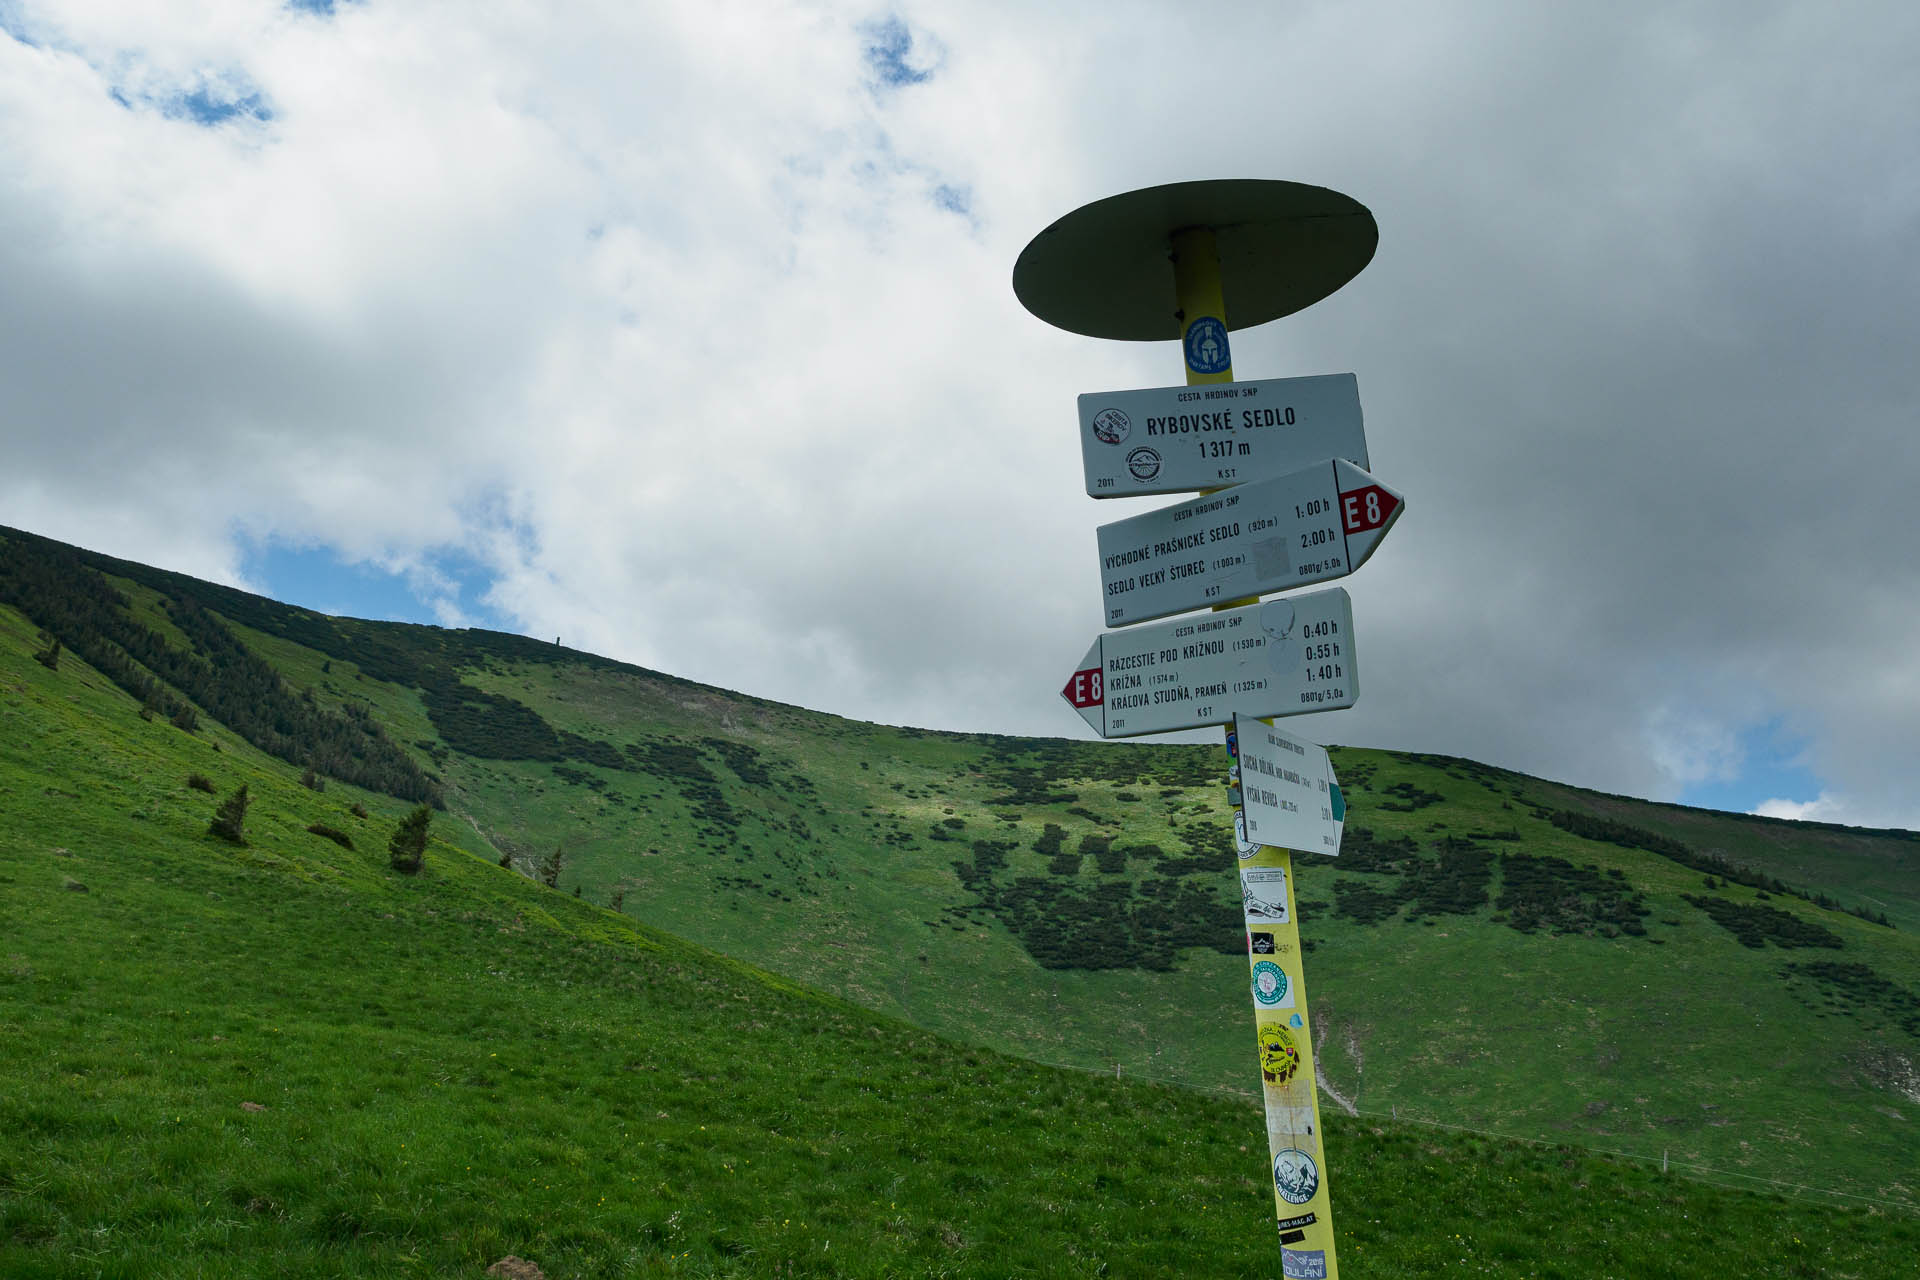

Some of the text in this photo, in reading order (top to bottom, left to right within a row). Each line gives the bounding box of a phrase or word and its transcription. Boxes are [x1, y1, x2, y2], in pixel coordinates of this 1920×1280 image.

[1178, 388, 1258, 402] CESTA HRDINOV SNP
[1147, 407, 1296, 436] RYBOVSKÉ SEDLO
[1097, 478, 1114, 488] 2011
[1218, 469, 1236, 479] KST
[1174, 495, 1240, 521] CESTA HRDINOV SNP
[1105, 545, 1150, 569] VÝCHODNÉ
[1155, 530, 1205, 557] PRAŠNICKÉ
[1210, 522, 1240, 542] SEDLO
[1301, 530, 1326, 548] 2:00
[1108, 577, 1135, 596] SEDLO
[1139, 567, 1165, 588] VEĽKÝ
[1170, 560, 1205, 580] ŠTUREC
[1205, 585, 1220, 597] KST
[1111, 608, 1124, 619] 2011
[1175, 617, 1242, 638] CESTA HRDINOV SNP
[1304, 621, 1328, 639] 0:40
[1109, 652, 1156, 672] RÁZCESTIE
[1160, 648, 1178, 663] POD
[1183, 640, 1224, 660] KRÍŽNOU
[1306, 643, 1330, 660] 0:55
[1110, 674, 1142, 691] KRÍŽNA
[1111, 692, 1149, 711] KRÁĽOVA
[1154, 685, 1193, 705] STUDŇA,
[1195, 682, 1227, 699] PRAMEŇ
[1197, 707, 1212, 718] KST
[1112, 719, 1125, 729] 2011
[1277, 1184, 1309, 1203] CHALLENGE
